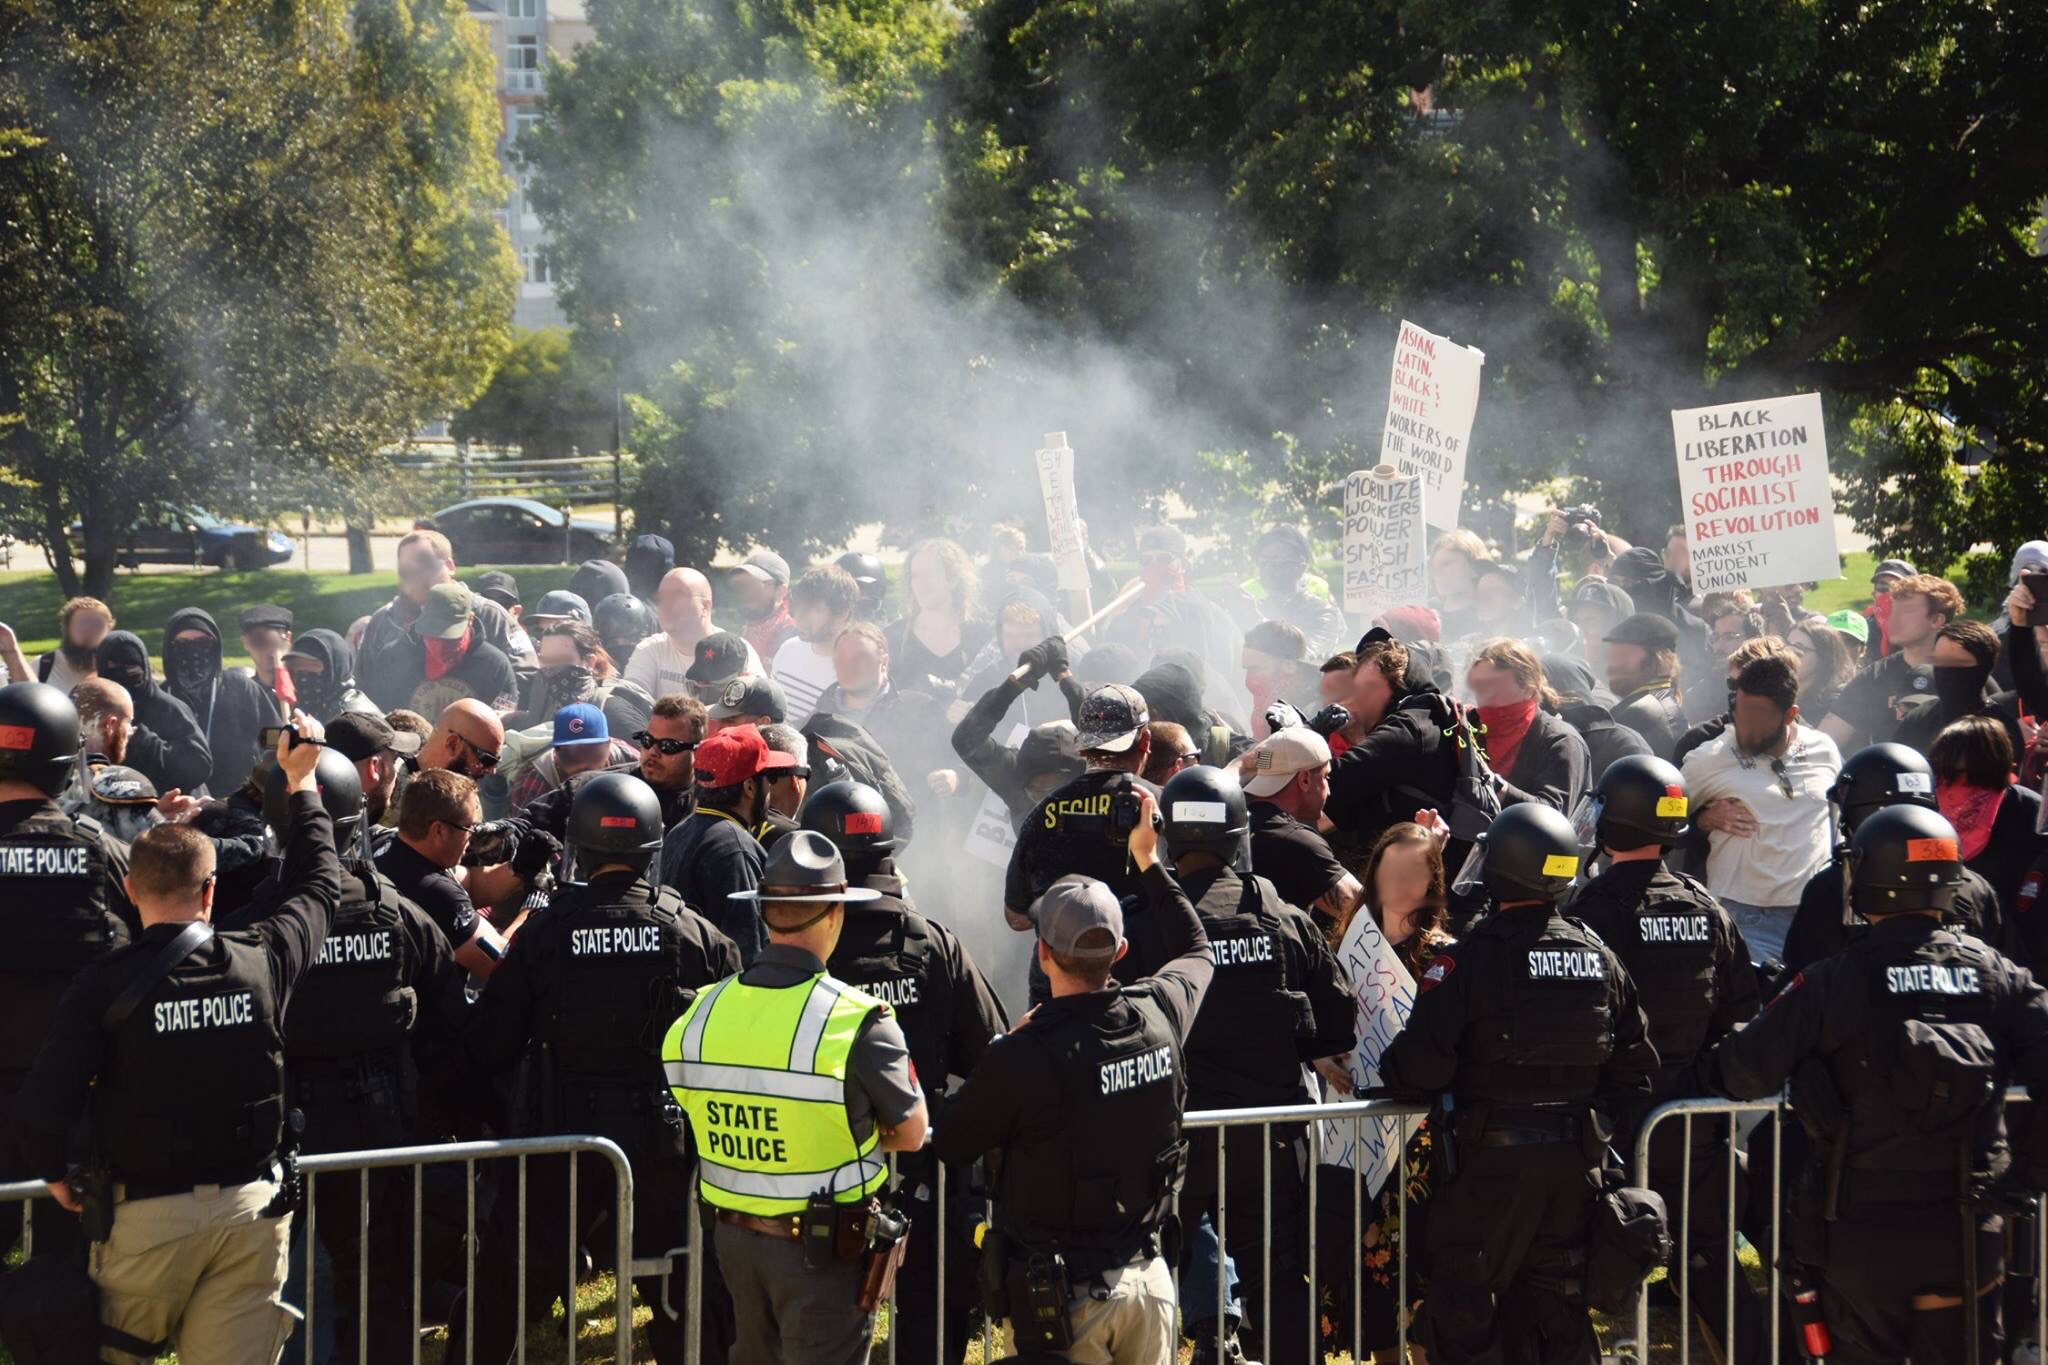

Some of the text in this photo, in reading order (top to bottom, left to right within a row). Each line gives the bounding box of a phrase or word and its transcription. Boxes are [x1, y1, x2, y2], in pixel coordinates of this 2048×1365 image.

[1401, 327, 1436, 360] ASIAN,
[1397, 351, 1432, 377] LATIN,
[1394, 369, 1430, 397] BLACK
[1393, 391, 1428, 418] WHITE
[1389, 411, 1461, 453] WORKERS OF
[1698, 410, 1773, 432] BLACK
[1387, 431, 1452, 474] THE WORLD
[1685, 426, 1808, 461] LIBERATION
[1703, 454, 1801, 484] THROUGH
[1345, 476, 1421, 501] MOBILIZE
[1692, 480, 1799, 516] SOCIALIST
[1345, 501, 1420, 519] WORKERS
[1695, 507, 1820, 541] REVOLUTION
[1345, 516, 1412, 539] POWER
[1347, 542, 1408, 567] SMASH
[1692, 540, 1755, 562] MARXIST
[1696, 552, 1771, 577] STUDENT
[1697, 571, 1748, 590] UNION
[1044, 793, 1112, 829] SECUR
[0, 847, 87, 874] TATE POLICE
[571, 926, 660, 955] STATE POLICE
[1640, 915, 1709, 942] STATE POLICE
[315, 932, 391, 965] ATE POLICE
[1230, 935, 1273, 963] POLICE
[1528, 951, 1603, 978] STATE POLICE
[873, 977, 919, 1006] POLICE
[1887, 964, 1980, 995] STATE POLICE
[154, 993, 253, 1032] STATE POLICE
[1101, 1046, 1173, 1095] STATE POLICE
[706, 1100, 779, 1132] STATE
[707, 1130, 788, 1163] POLICE
